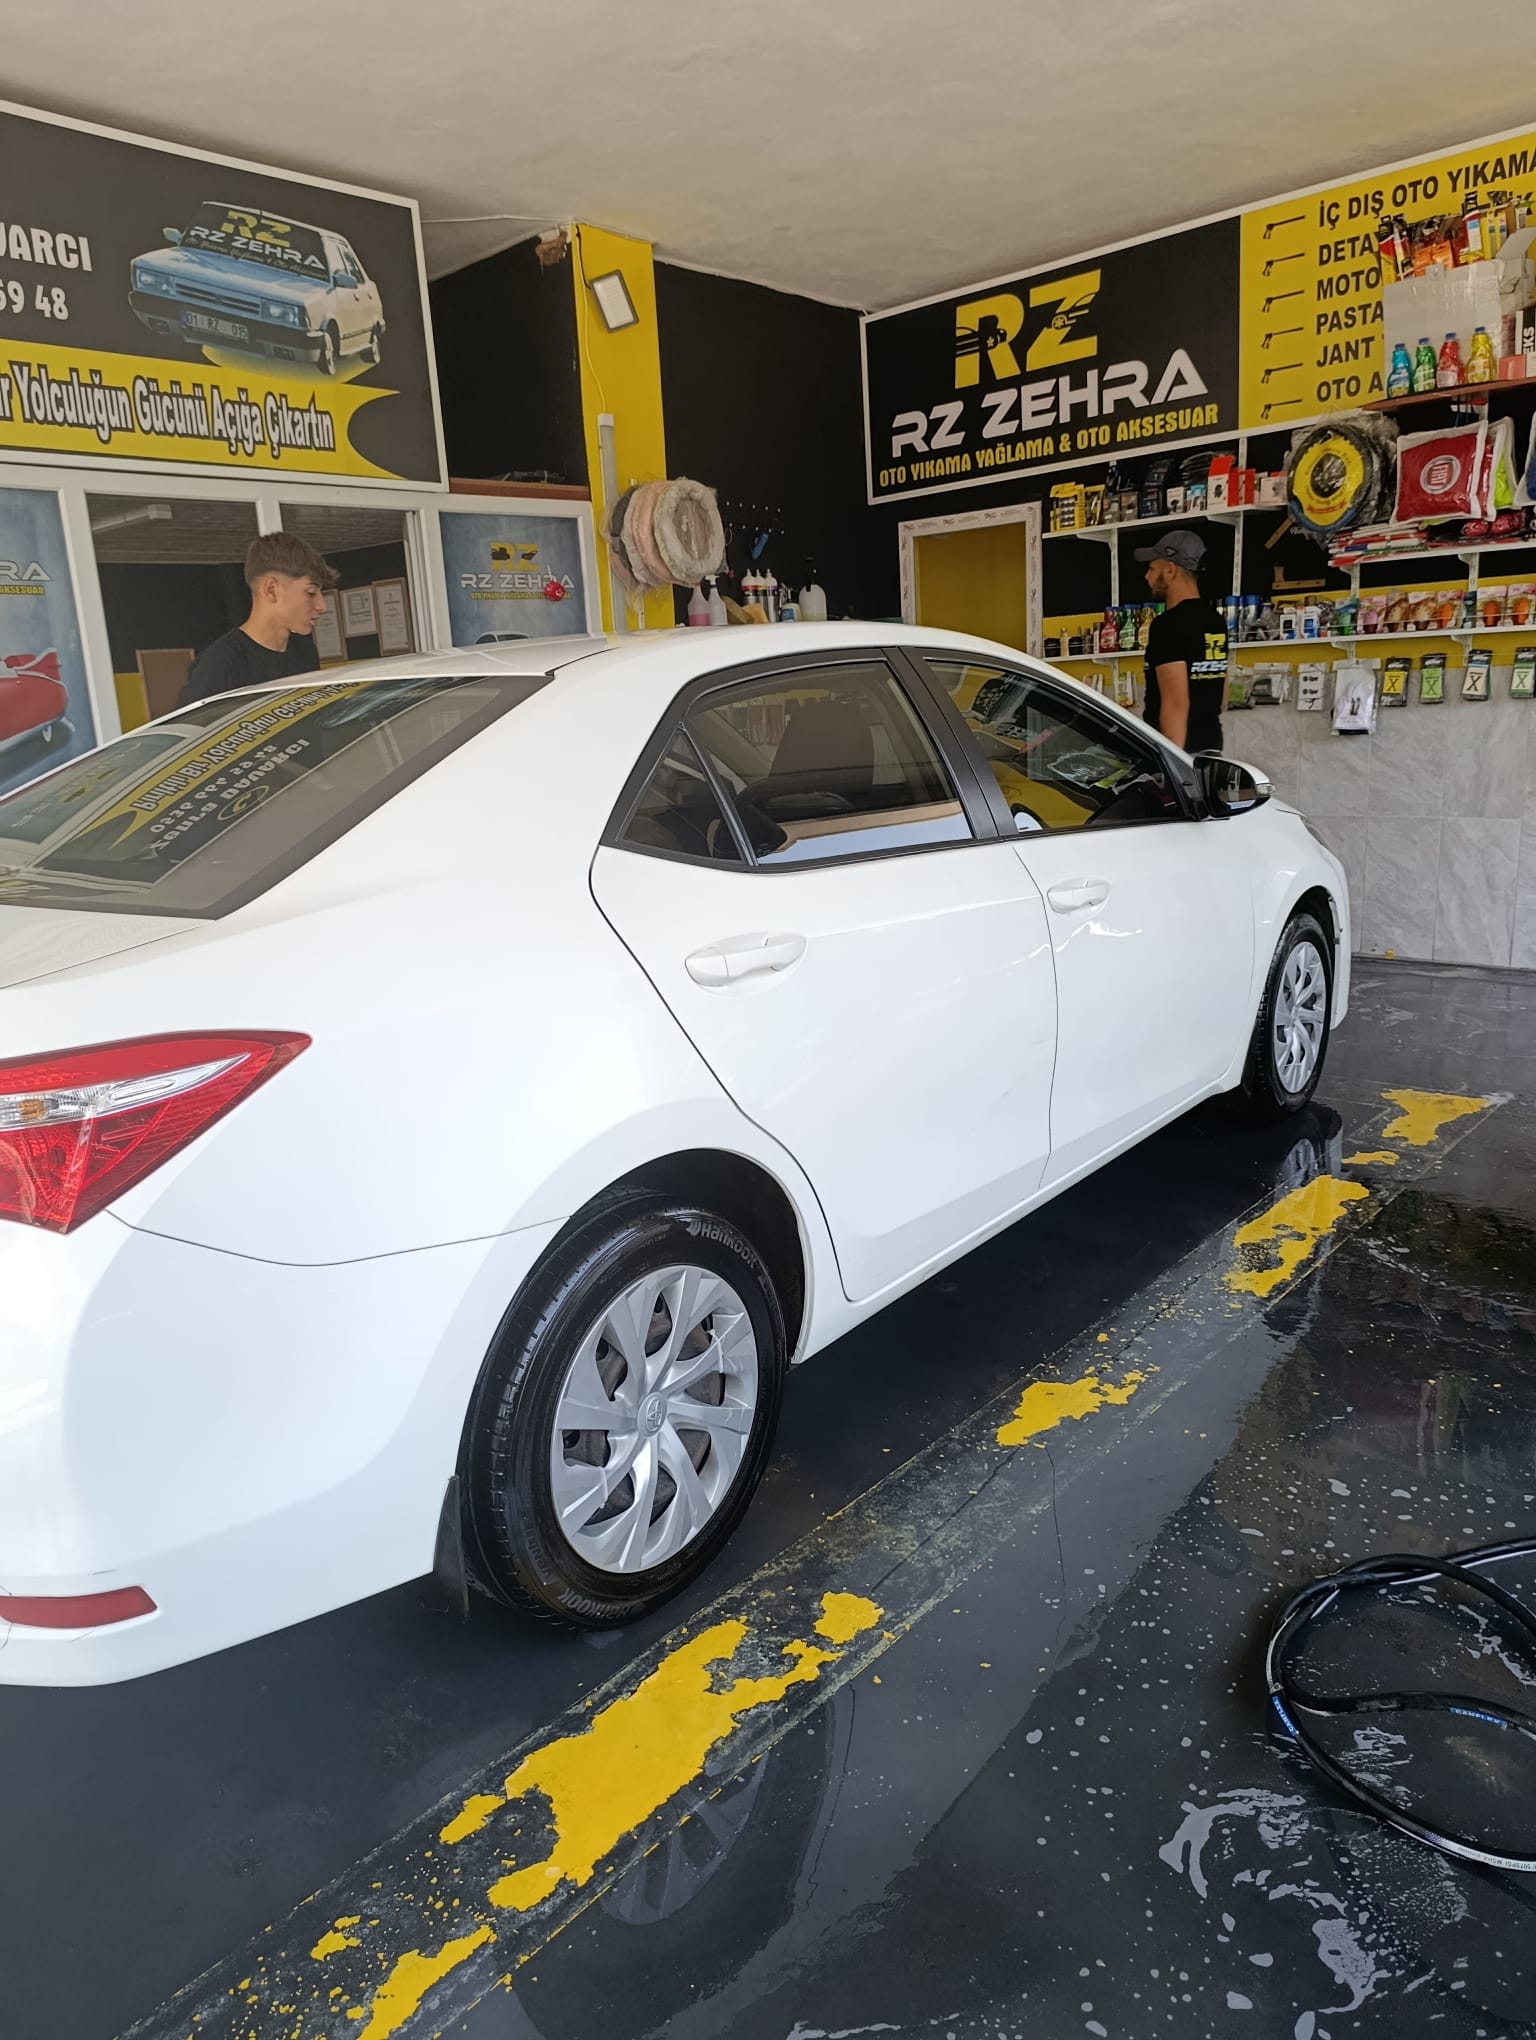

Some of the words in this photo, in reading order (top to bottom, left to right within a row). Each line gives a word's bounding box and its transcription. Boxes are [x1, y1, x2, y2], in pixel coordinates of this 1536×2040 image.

[1319, 200, 1340, 231] İÇ
[1348, 190, 1384, 219] DIŞ
[1392, 175, 1439, 208] OTO
[0, 222, 92, 272] ARCI
[190, 226, 227, 243] RZ
[232, 236, 326, 270] ZEHRA
[221, 210, 292, 248] RZ
[1318, 231, 1380, 266] DETA
[35, 285, 69, 320] 48
[207, 316, 220, 331] RZ
[955, 268, 1101, 389] RZ
[1316, 336, 1375, 367] JANT
[891, 400, 966, 458] RZ
[981, 348, 1209, 439] ZEHRA
[1316, 375, 1361, 403] OTO
[10, 362, 134, 443] Yolculuğun
[133, 375, 209, 438] Gücünü
[211, 385, 265, 456] Açığa
[264, 392, 336, 458] Çıkartın
[879, 466, 907, 487] OTO
[911, 453, 971, 481] YIKAMA
[975, 436, 1054, 469] YAĞLAMA
[1058, 433, 1072, 453] &
[1076, 425, 1111, 450] OTO
[1116, 403, 1219, 442] AKSESUAR
[490, 542, 539, 571] RZ
[461, 573, 493, 589] RZ
